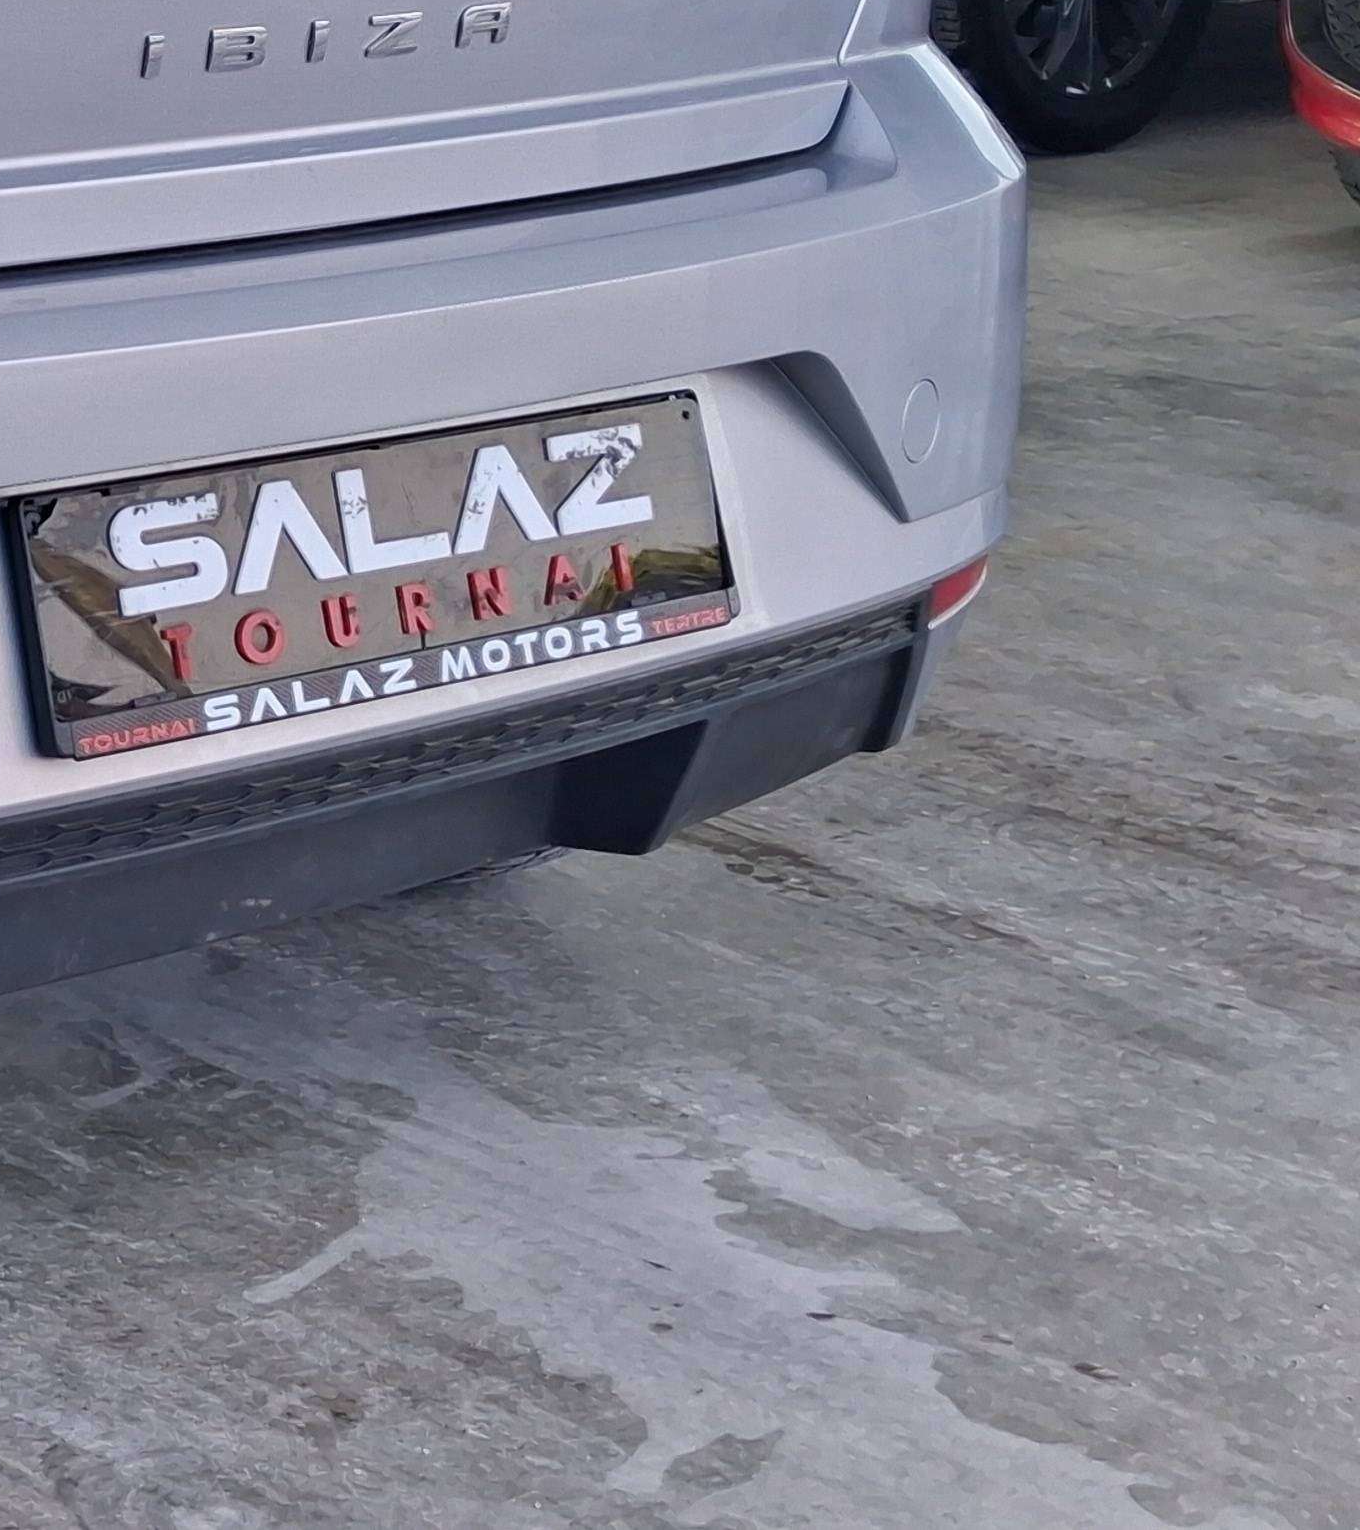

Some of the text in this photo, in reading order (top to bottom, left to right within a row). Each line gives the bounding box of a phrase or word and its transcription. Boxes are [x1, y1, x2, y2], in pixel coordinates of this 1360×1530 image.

[140, 1, 513, 79] IBIZA
[109, 422, 654, 617] SALAZ
[78, 717, 197, 755] TOURNAI
[202, 659, 418, 733] SALAZ
[439, 609, 644, 684] MOTORS
[160, 543, 635, 683] TOURNAI
